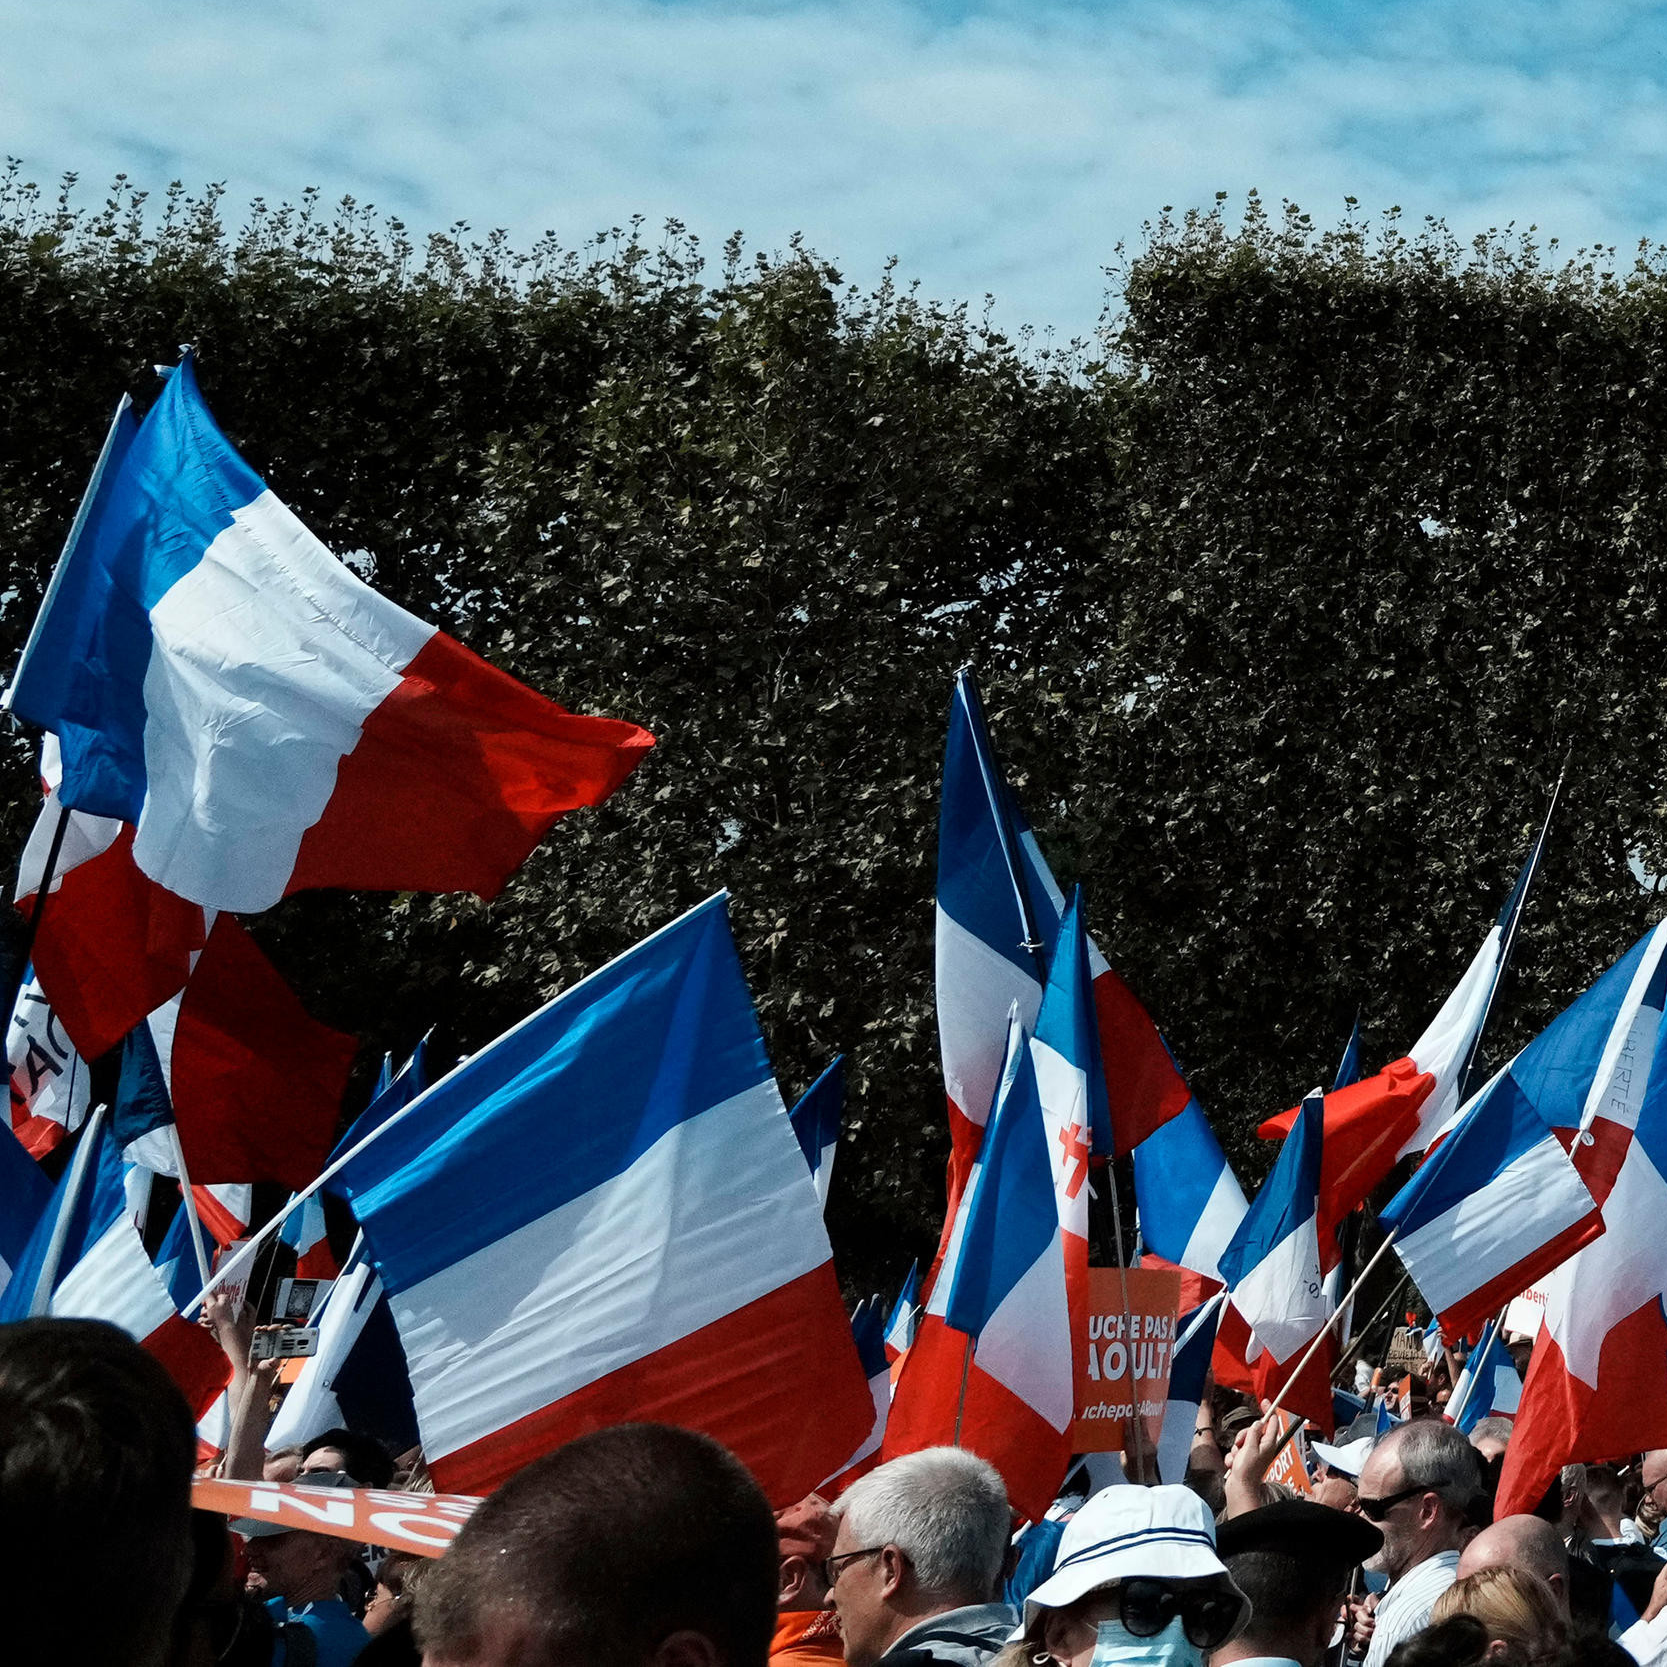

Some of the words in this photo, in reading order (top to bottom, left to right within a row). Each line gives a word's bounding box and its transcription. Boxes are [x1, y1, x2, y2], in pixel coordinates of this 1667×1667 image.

[1088, 1314, 1140, 1341] UCHE
[1144, 1315, 1169, 1340] PAS
[1087, 1342, 1168, 1381] AOULT
